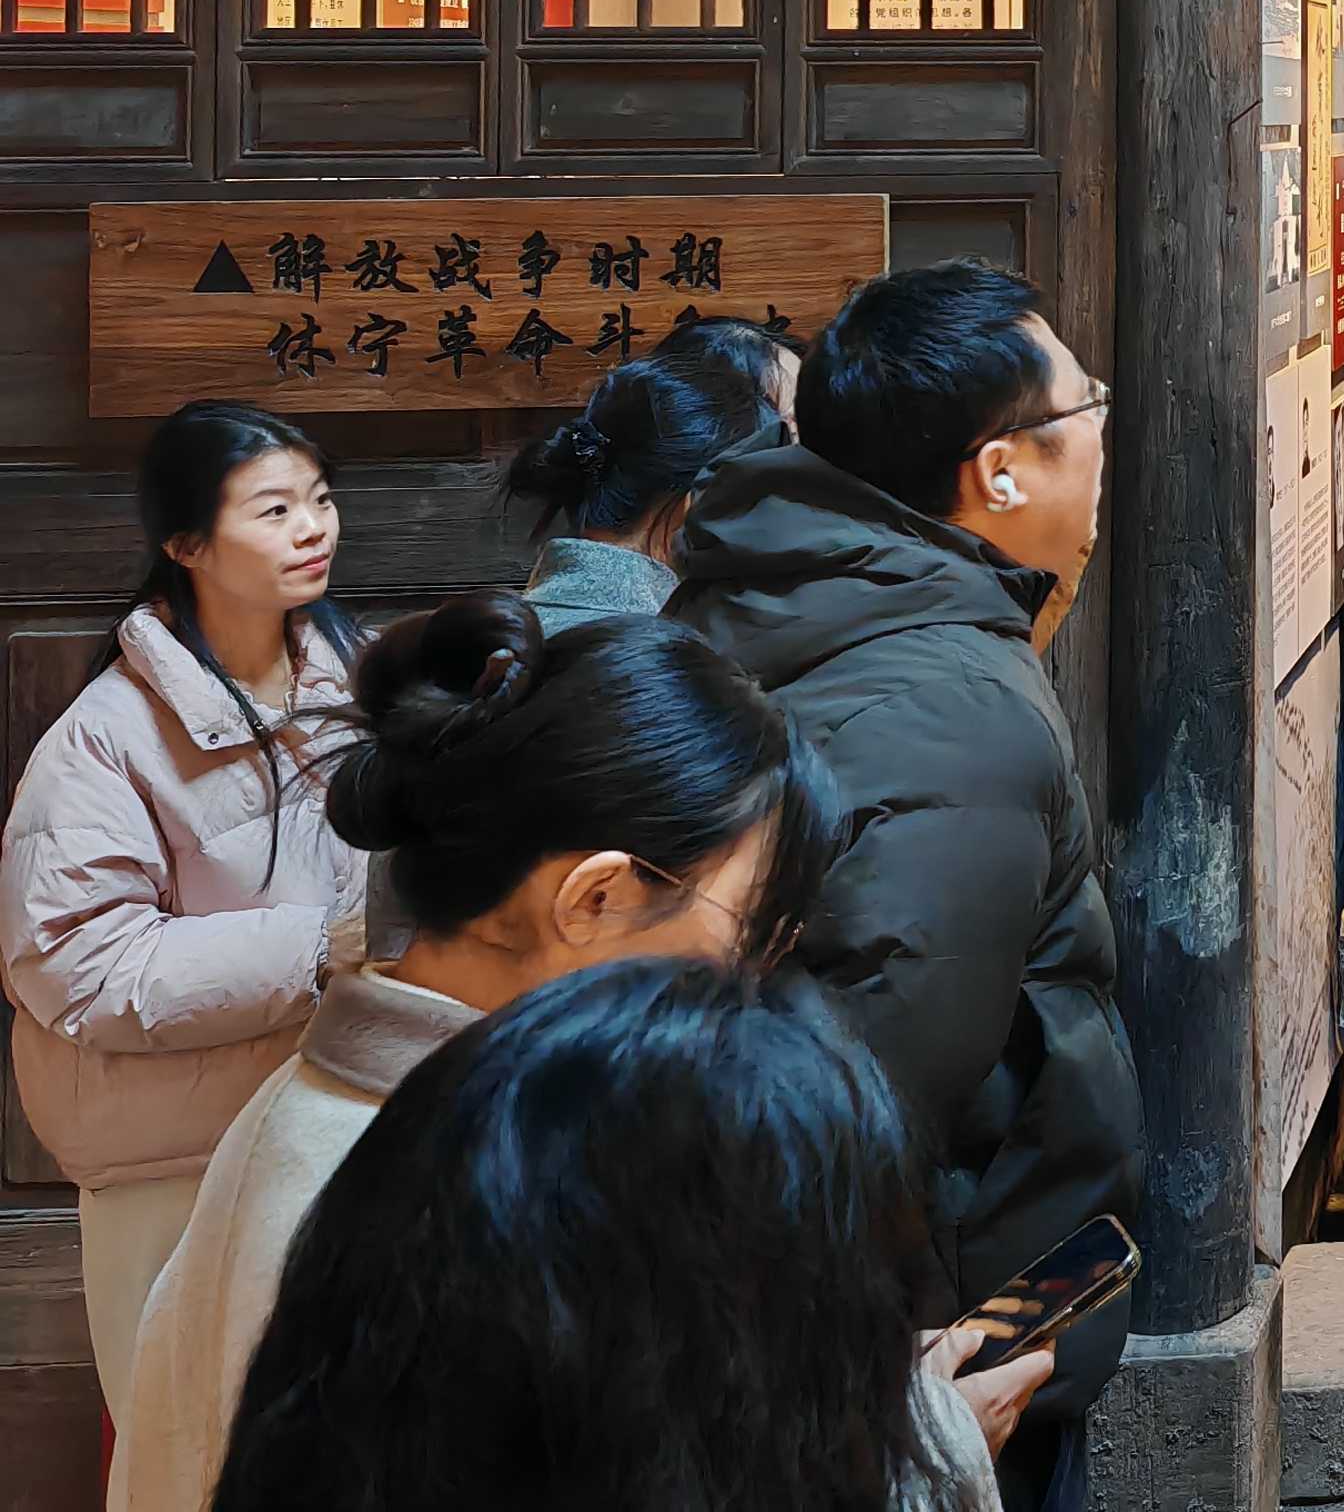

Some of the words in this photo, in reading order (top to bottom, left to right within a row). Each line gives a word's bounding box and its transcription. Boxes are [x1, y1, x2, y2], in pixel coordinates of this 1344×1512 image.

[268, 230, 723, 304] 解放战争时期
